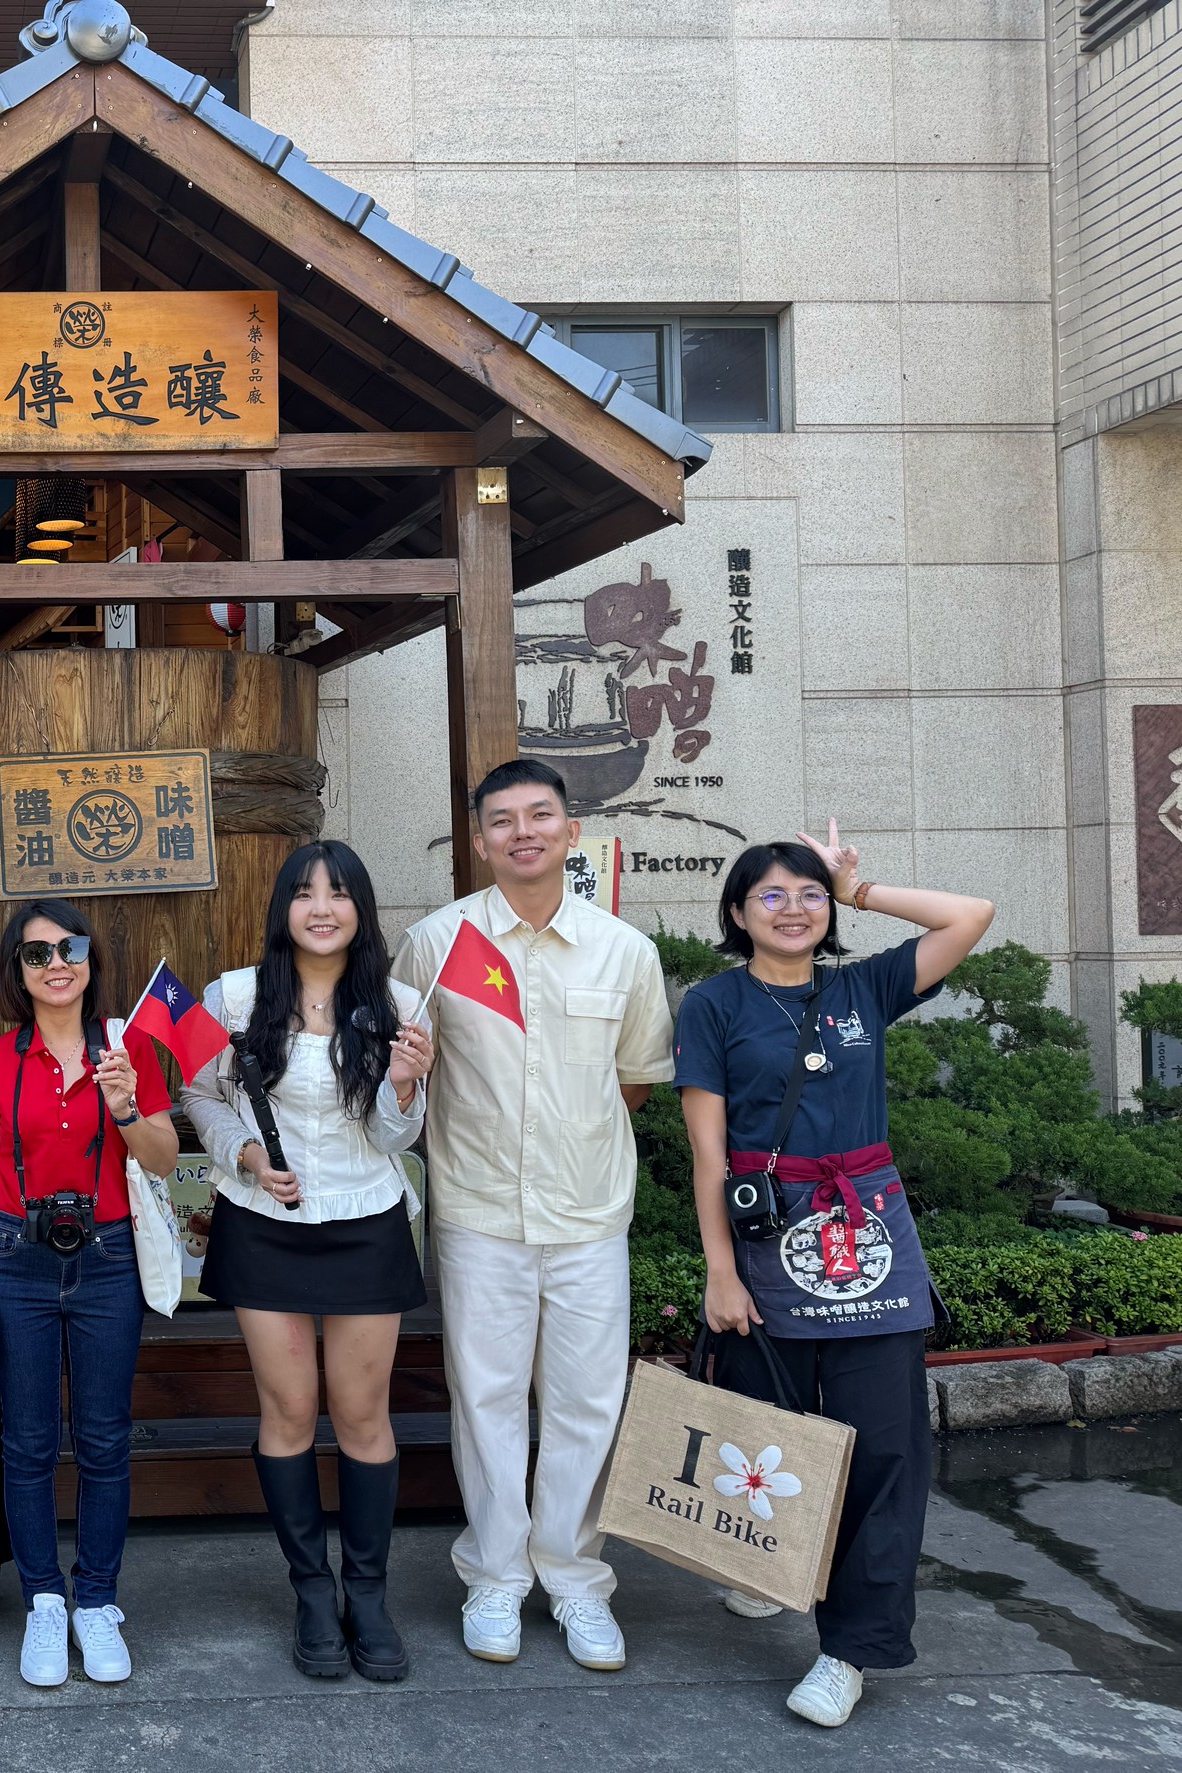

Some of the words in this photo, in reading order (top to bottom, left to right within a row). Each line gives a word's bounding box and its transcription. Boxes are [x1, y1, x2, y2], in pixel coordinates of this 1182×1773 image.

[246, 303, 266, 405] 大榮食品廠
[726, 548, 754, 675] 釀造文化館
[653, 776, 691, 788] SINCE
[694, 775, 723, 787] 1950
[13, 788, 55, 868] 醬油
[154, 781, 195, 862] 味噌
[631, 851, 727, 878] Factory
[789, 1296, 910, 1318] 台灣味噌釀造文化館
[672, 1424, 712, 1490] I
[645, 1483, 705, 1525] Rail
[712, 1507, 779, 1554] Bike
